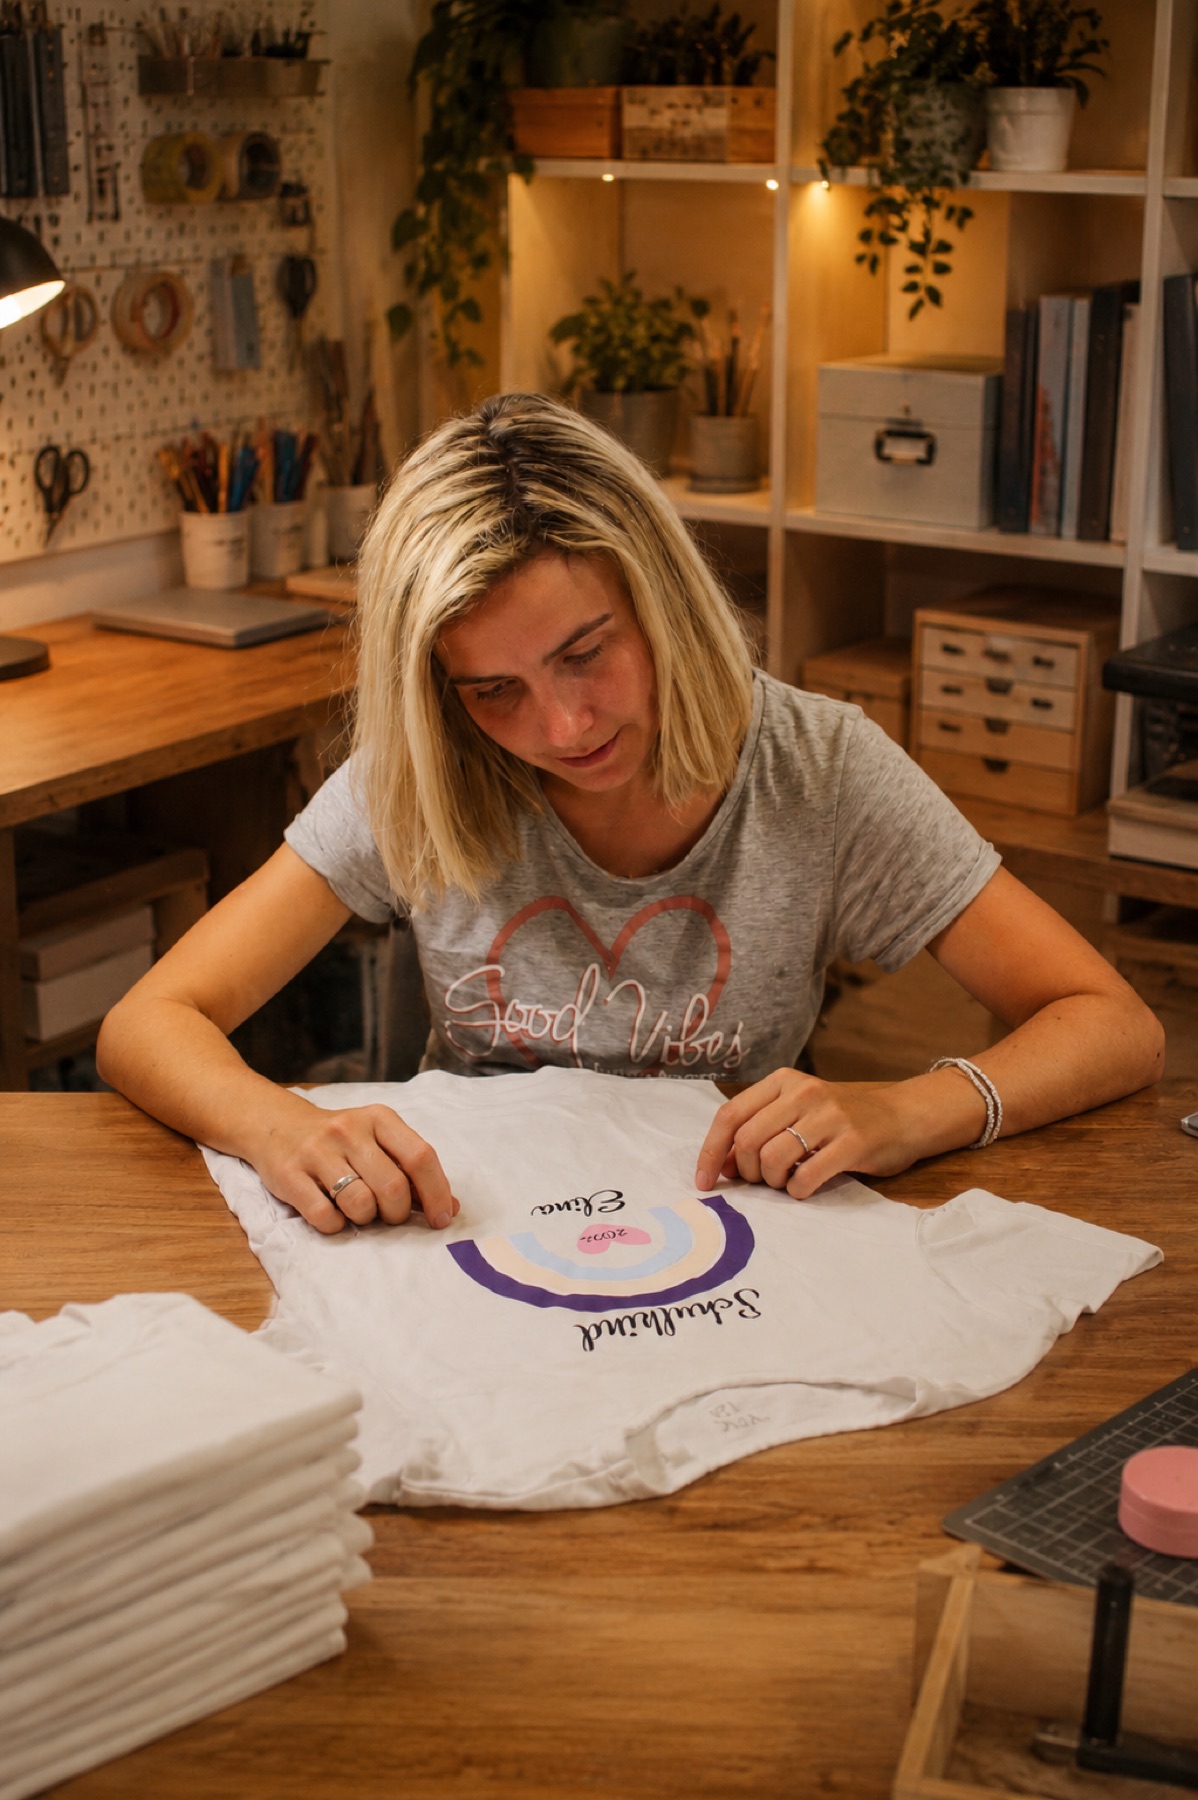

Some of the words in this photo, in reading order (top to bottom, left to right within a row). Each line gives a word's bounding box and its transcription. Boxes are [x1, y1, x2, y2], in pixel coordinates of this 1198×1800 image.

[445, 963, 600, 1068] Good
[603, 979, 749, 1068] Vibes
[531, 1190, 625, 1216] Elina
[574, 1288, 761, 1352] Schulkind
